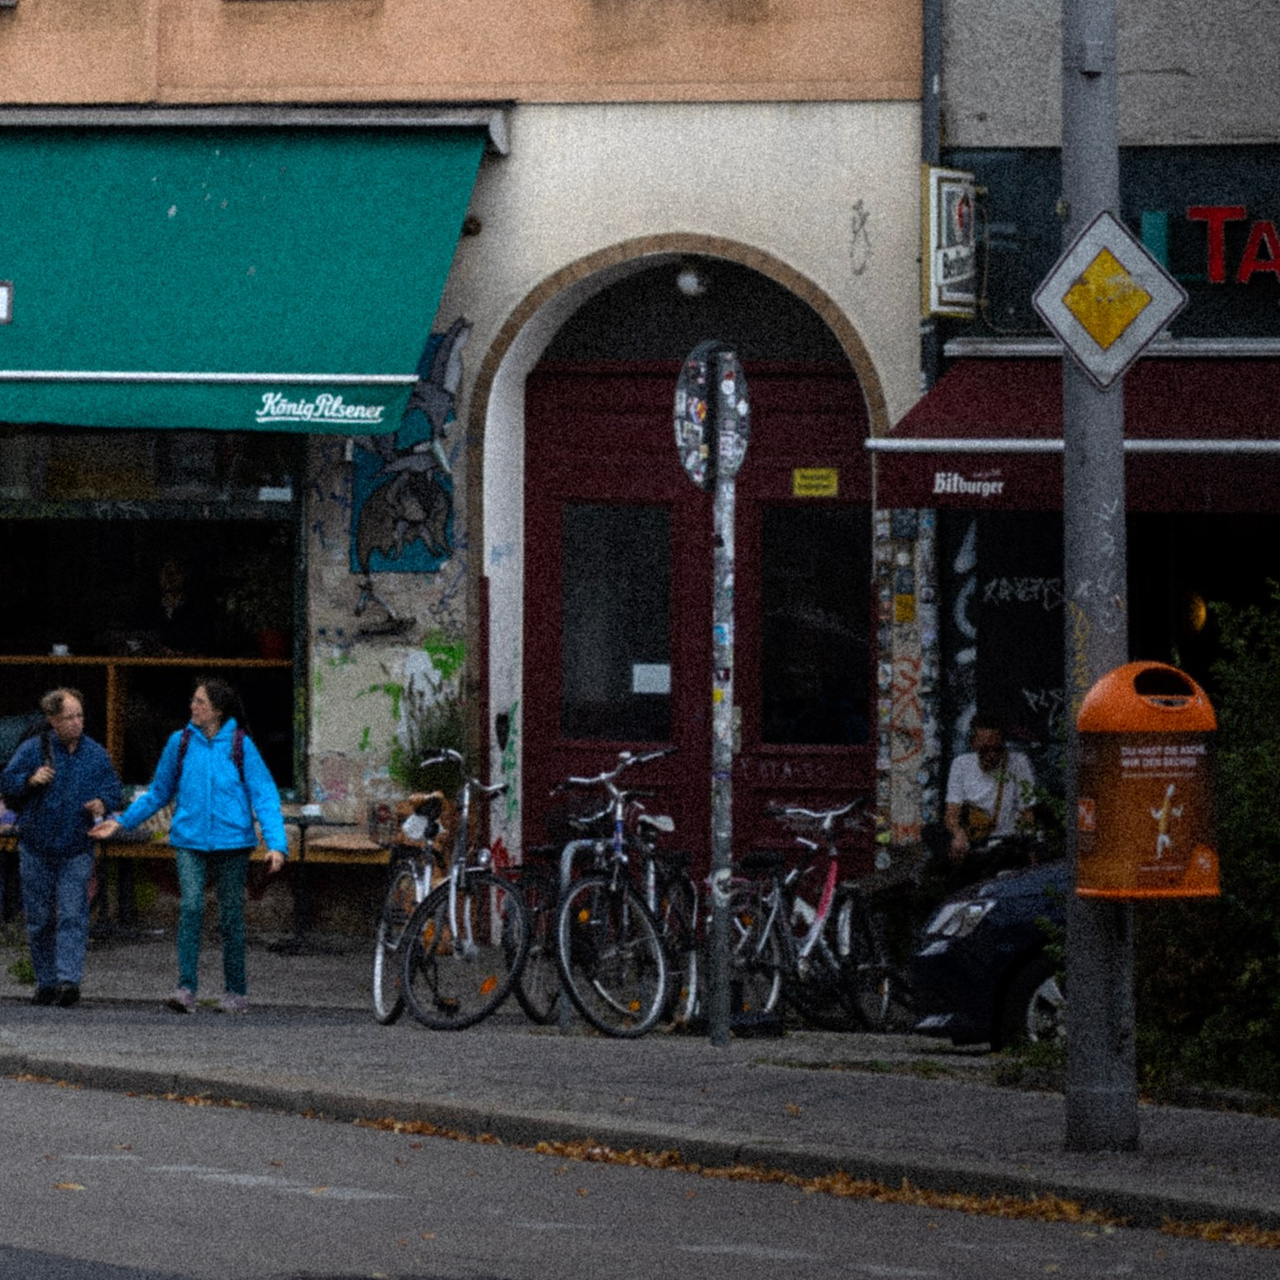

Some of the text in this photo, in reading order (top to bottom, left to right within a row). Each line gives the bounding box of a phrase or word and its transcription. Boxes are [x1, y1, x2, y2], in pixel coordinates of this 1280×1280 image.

[256, 392, 384, 420] König Pilsener
[932, 471, 1004, 497] Bitburger
